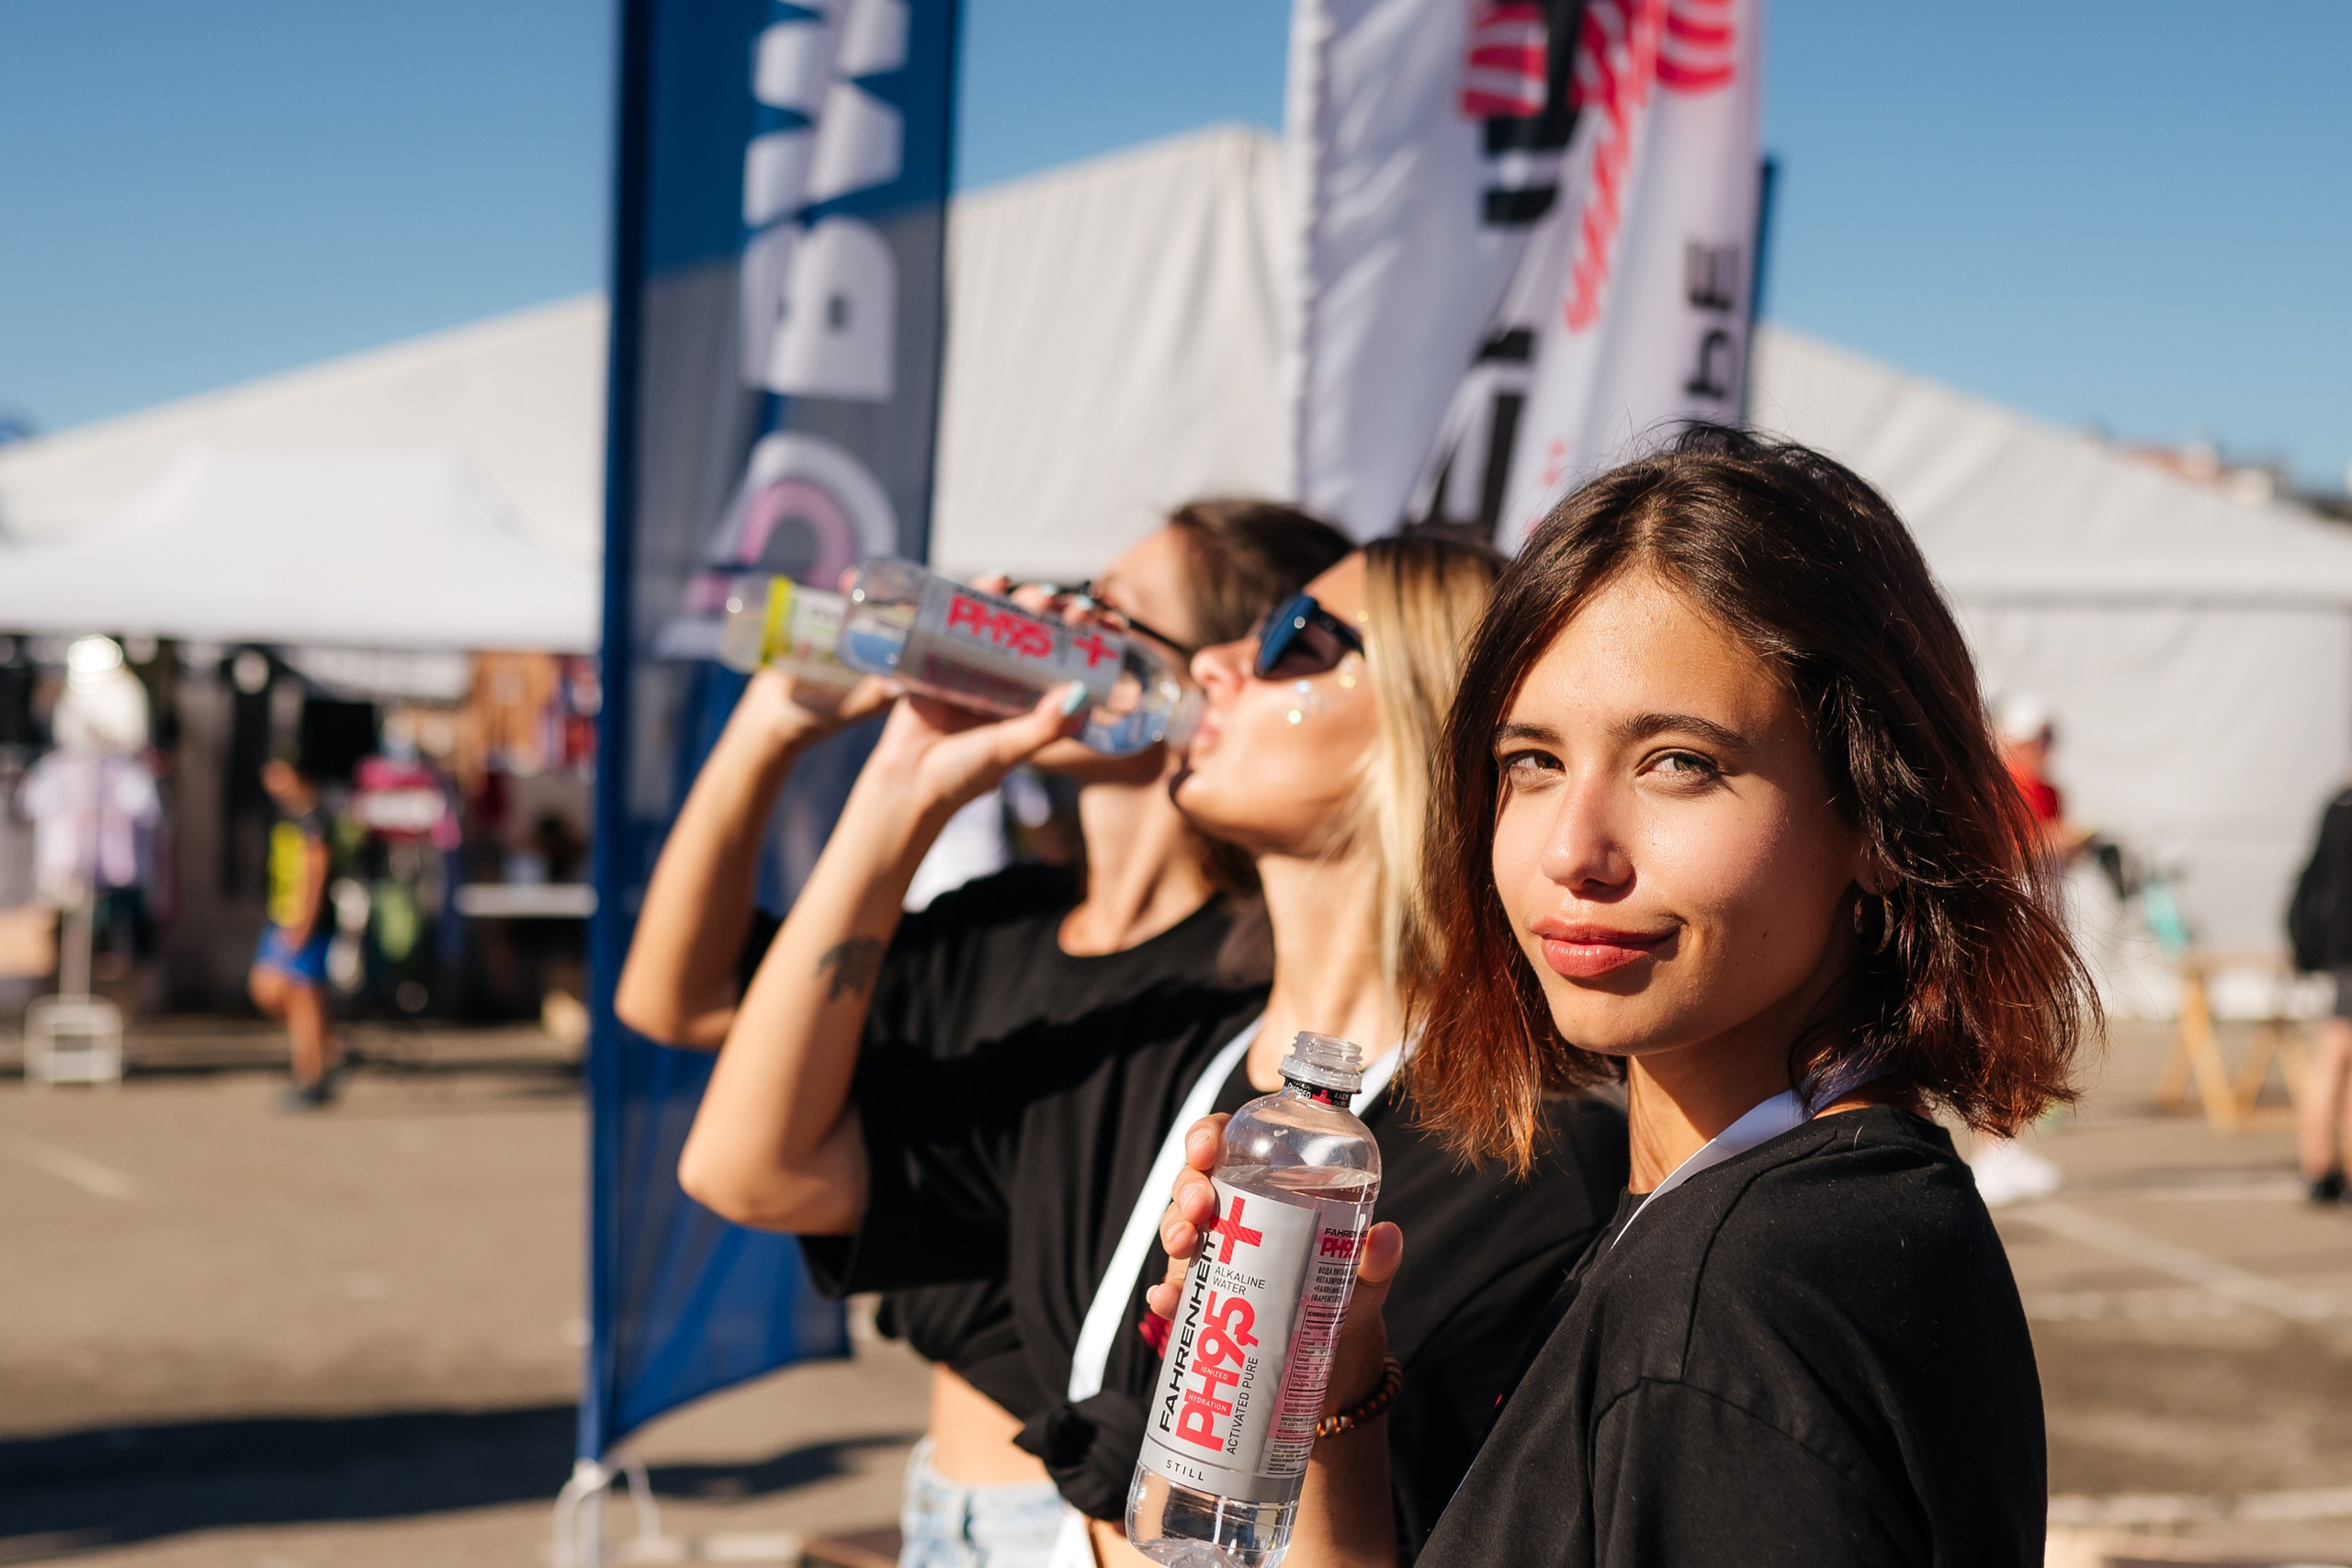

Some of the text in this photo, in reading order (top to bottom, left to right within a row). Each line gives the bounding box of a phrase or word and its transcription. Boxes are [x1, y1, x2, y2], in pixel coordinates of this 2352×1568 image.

[1213, 1276, 1247, 1295] WATER
[1215, 1266, 1266, 1290] ALKALINE
[1159, 1232, 1216, 1433] FAHRENHEIT
[1200, 1366, 1228, 1381] IONIZED
[1188, 1393, 1227, 1412] HYDRATION
[1227, 1357, 1259, 1455] ACTIVATED PURE
[1166, 1460, 1204, 1482] STILL
